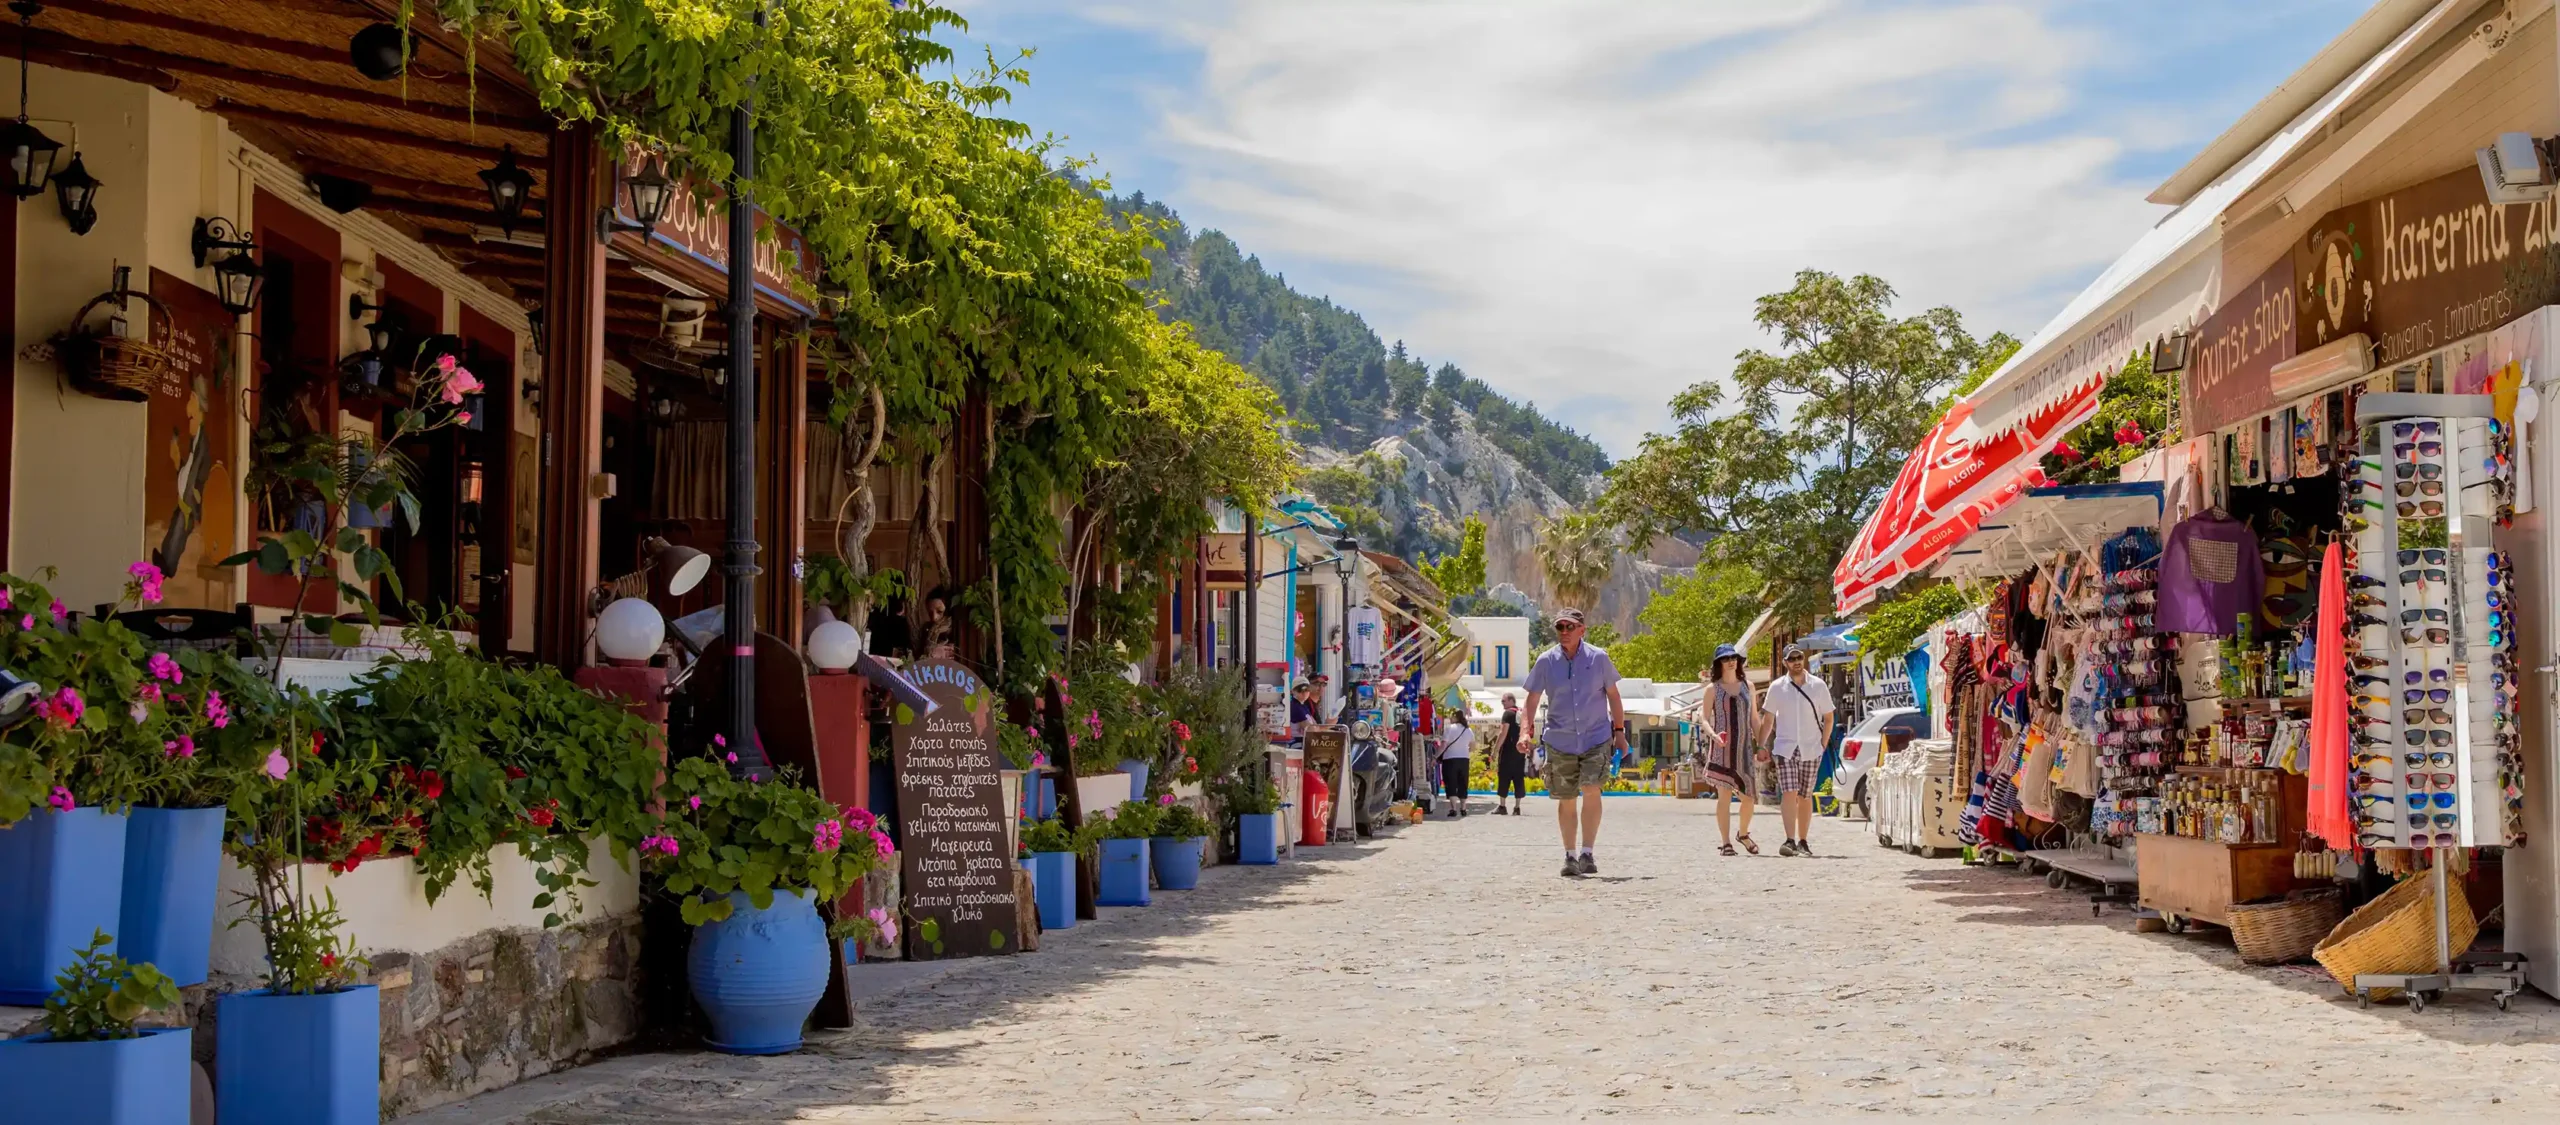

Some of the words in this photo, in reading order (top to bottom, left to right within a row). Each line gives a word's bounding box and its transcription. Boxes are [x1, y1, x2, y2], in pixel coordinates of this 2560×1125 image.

[2380, 198, 2510, 285] Katerina
[2381, 319, 2434, 363] Souvenirs
[2444, 288, 2511, 340] Embroideries
[2191, 318, 2249, 402] Tourist
[2254, 280, 2292, 361] shop
[2014, 367, 2048, 413] TOURIST
[2049, 348, 2075, 395] SHOP
[2082, 310, 2133, 375] KATERINA
[1947, 459, 1985, 489] ALGIDA
[1923, 527, 1954, 551] ALGIDA
[926, 718, 972, 734] Σαλάτες
[909, 736, 943, 755] Χόρτα
[949, 736, 987, 750] εποχής
[1311, 739, 1338, 748] MAGIC
[906, 753, 954, 769] Σπιτικούς
[957, 754, 991, 772] μεζέδες
[901, 771, 944, 791] Φρέσκες
[929, 785, 975, 799] πατάτες
[922, 803, 988, 822] Παραδοσιακό
[908, 818, 950, 838] γεμιστό
[954, 819, 1001, 833] κατσικάκι
[930, 837, 993, 859] Μαγειρευτά
[918, 857, 957, 872] Ντόπια
[966, 855, 1003, 875] κρέατα
[927, 877, 946, 887] στα
[914, 892, 952, 907] Σπιτικό
[956, 891, 1015, 909] παραδοσιακό
[951, 905, 982, 923] γλυκό
